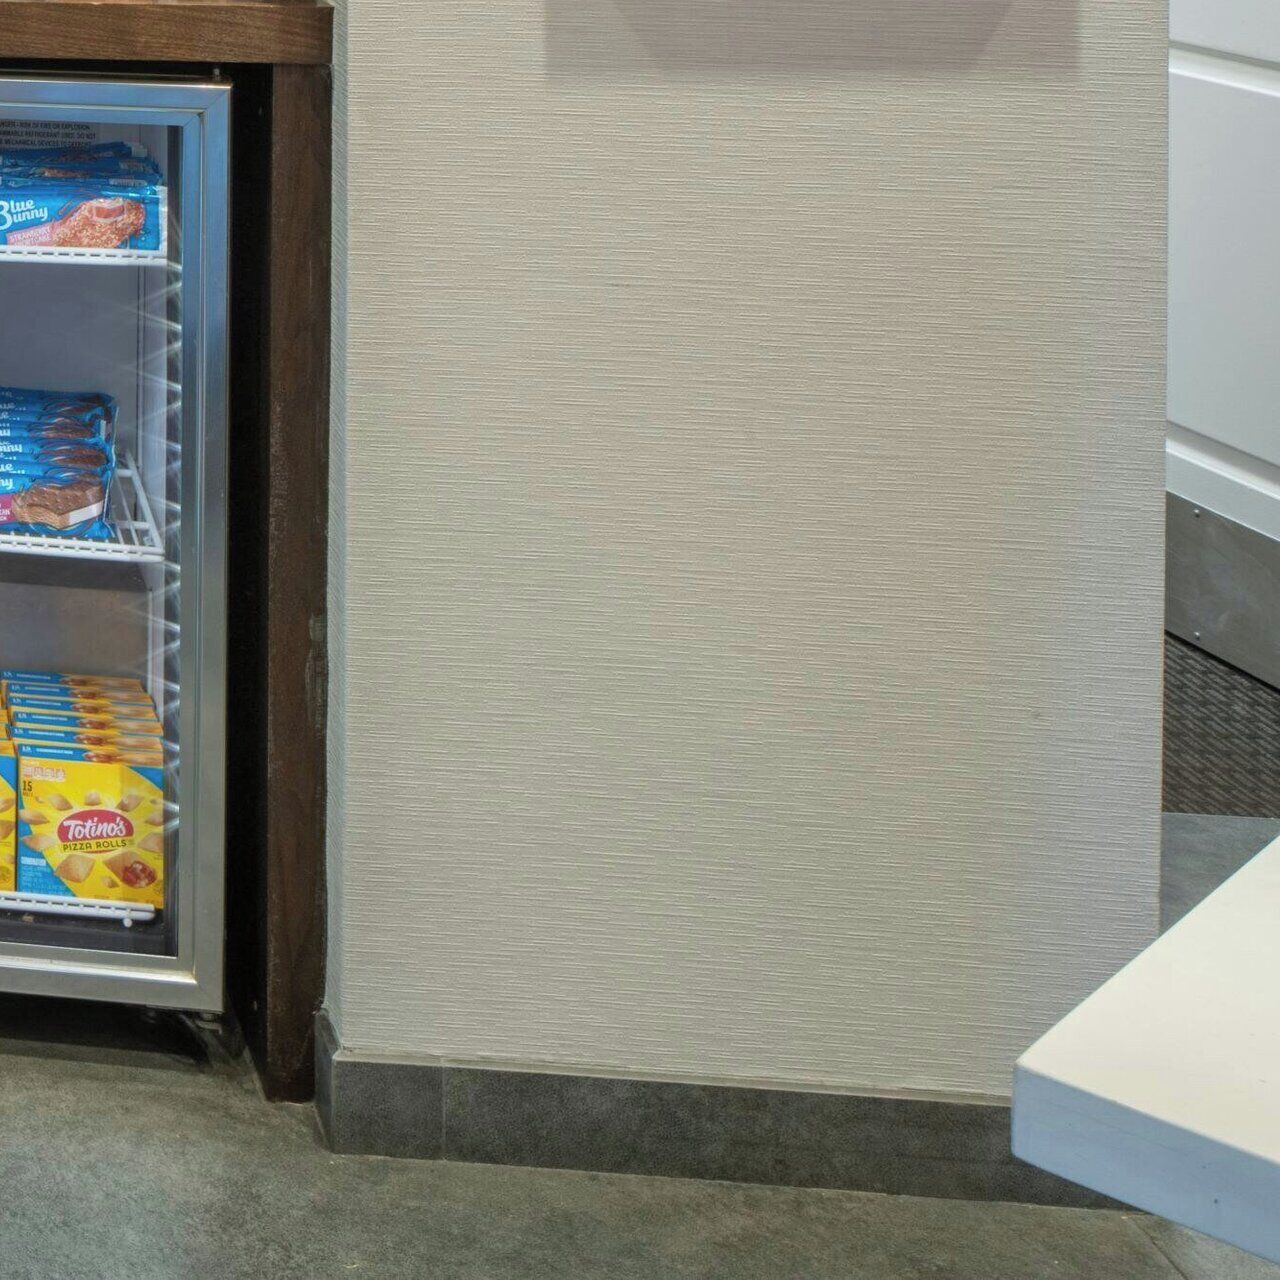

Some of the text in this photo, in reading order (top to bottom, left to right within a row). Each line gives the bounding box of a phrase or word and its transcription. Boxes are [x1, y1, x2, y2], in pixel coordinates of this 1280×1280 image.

[22, 780, 34, 793] 15
[63, 812, 127, 840] Totino's
[62, 838, 128, 852] PIZZA ROLLS
